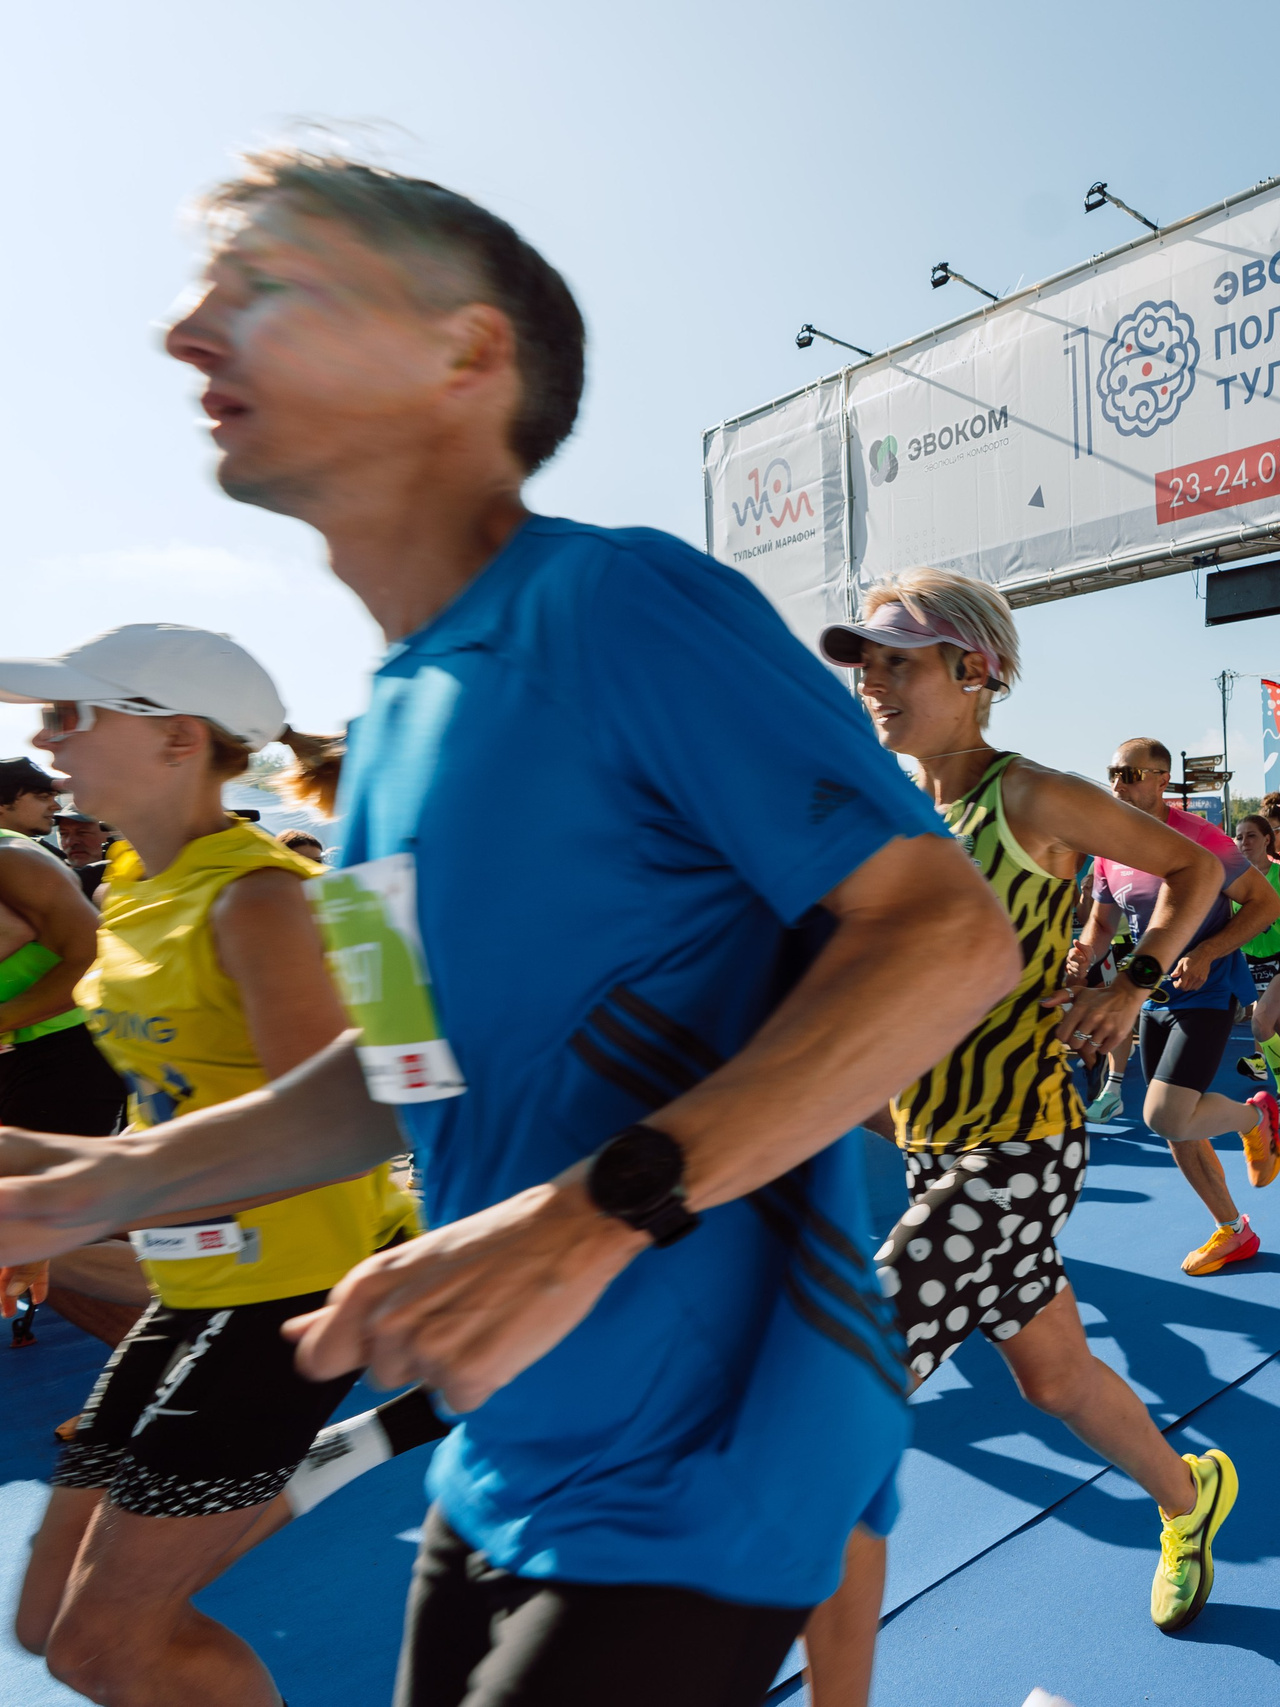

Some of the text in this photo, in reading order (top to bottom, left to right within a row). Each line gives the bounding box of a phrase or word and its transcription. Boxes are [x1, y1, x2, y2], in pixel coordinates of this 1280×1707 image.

[907, 404, 1010, 462] ЭВОКОМ
[732, 527, 817, 563] ТУЛЬСКИЙ МАРАФОН
